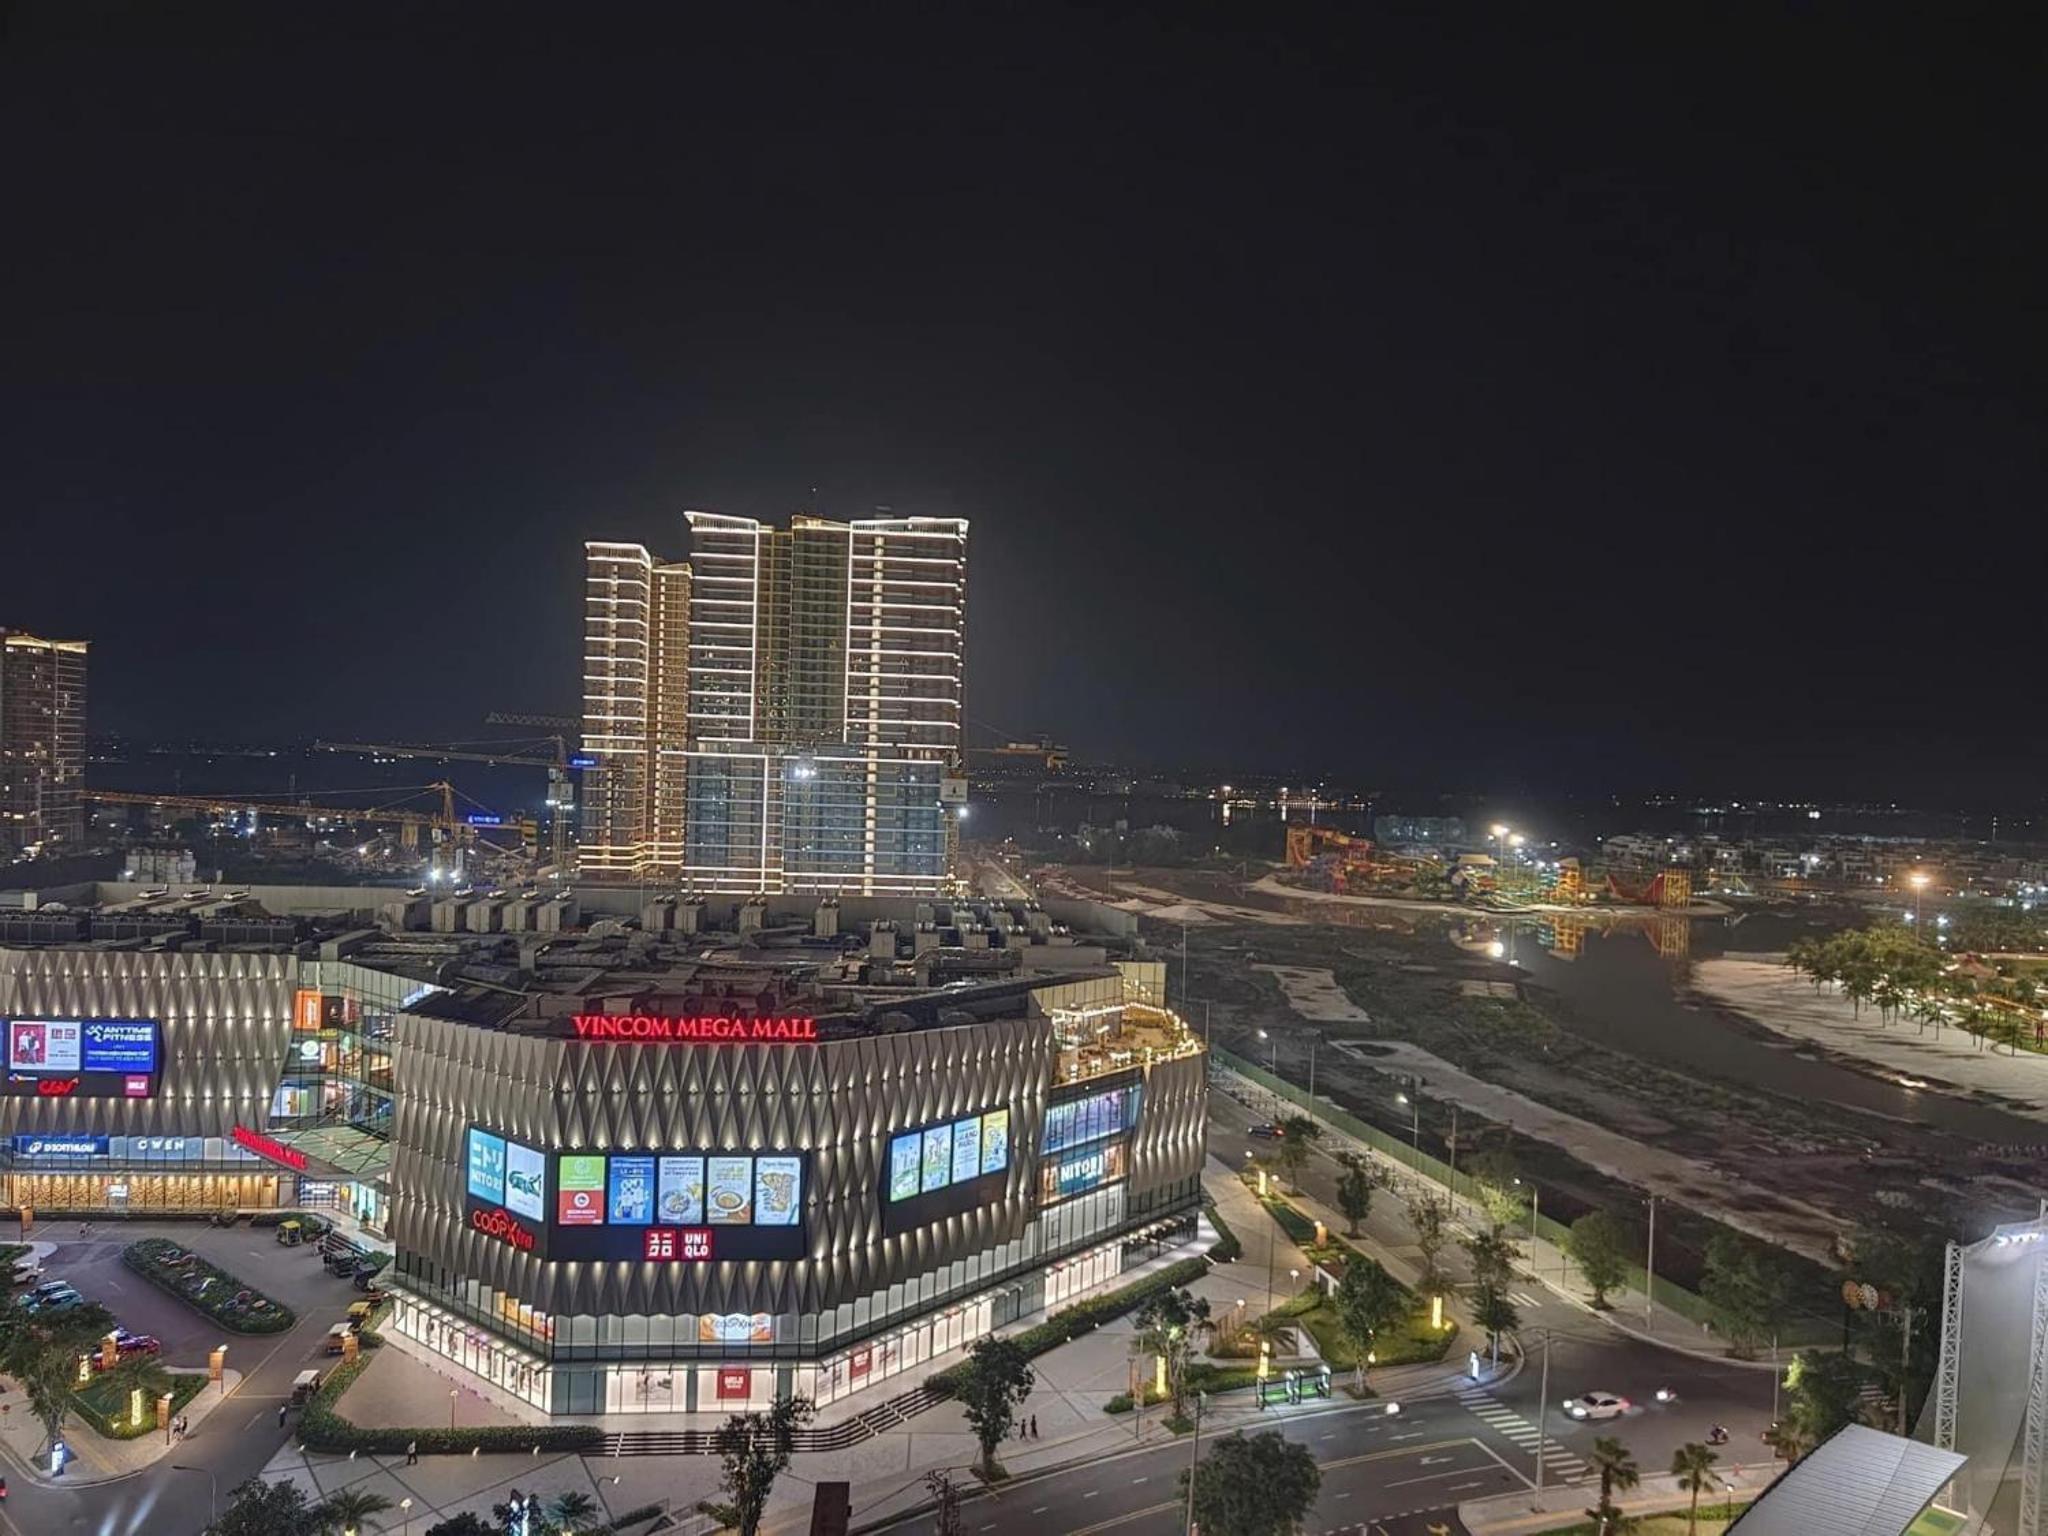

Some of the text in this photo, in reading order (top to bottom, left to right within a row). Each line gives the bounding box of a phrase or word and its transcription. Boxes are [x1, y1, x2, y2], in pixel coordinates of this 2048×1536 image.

[103, 1027, 152, 1035] ANYTIME
[573, 1015, 816, 1038] VINCOM MEGA MALL
[103, 1034, 152, 1042] FITNESS
[138, 1140, 184, 1150] OWEN
[684, 1233, 707, 1245] UNI
[684, 1245, 709, 1257] QLO
